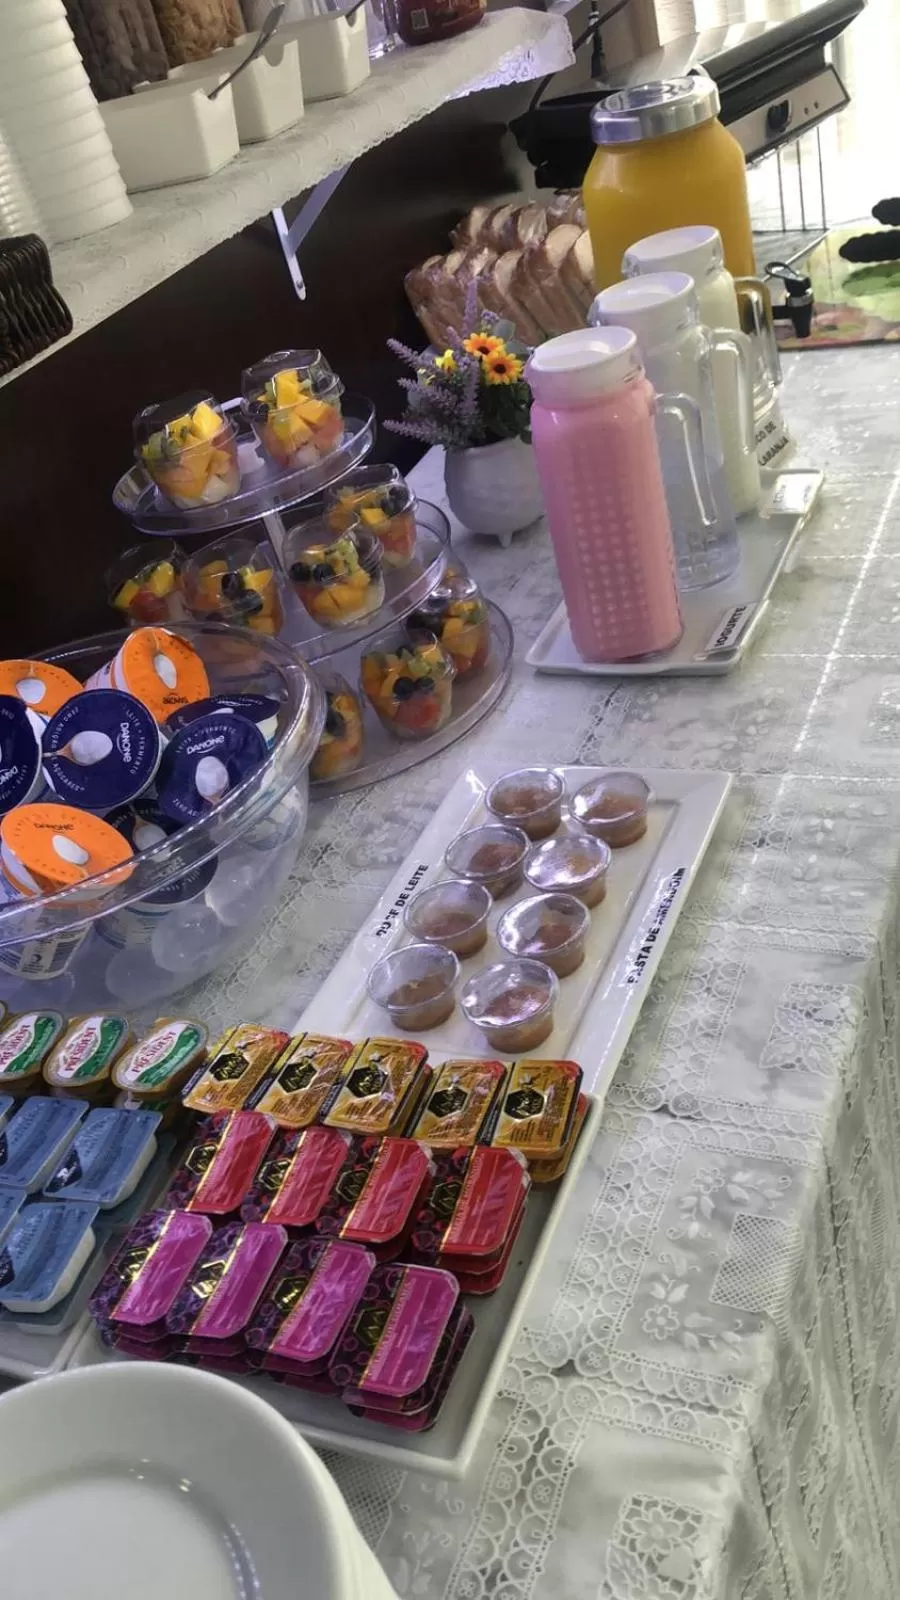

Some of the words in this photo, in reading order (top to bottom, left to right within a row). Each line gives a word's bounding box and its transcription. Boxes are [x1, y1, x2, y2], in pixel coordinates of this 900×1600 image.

[755, 430, 767, 446] CO
[764, 420, 777, 434] DE
[757, 435, 789, 466] LARANJA
[714, 606, 747, 648] IOGURTE
[119, 721, 132, 763] DANONE
[186, 735, 225, 755] DANONE
[394, 892, 410, 907] DE
[404, 864, 429, 891] LEITE
[626, 945, 653, 984] PASTA
[644, 927, 661, 943] DE
